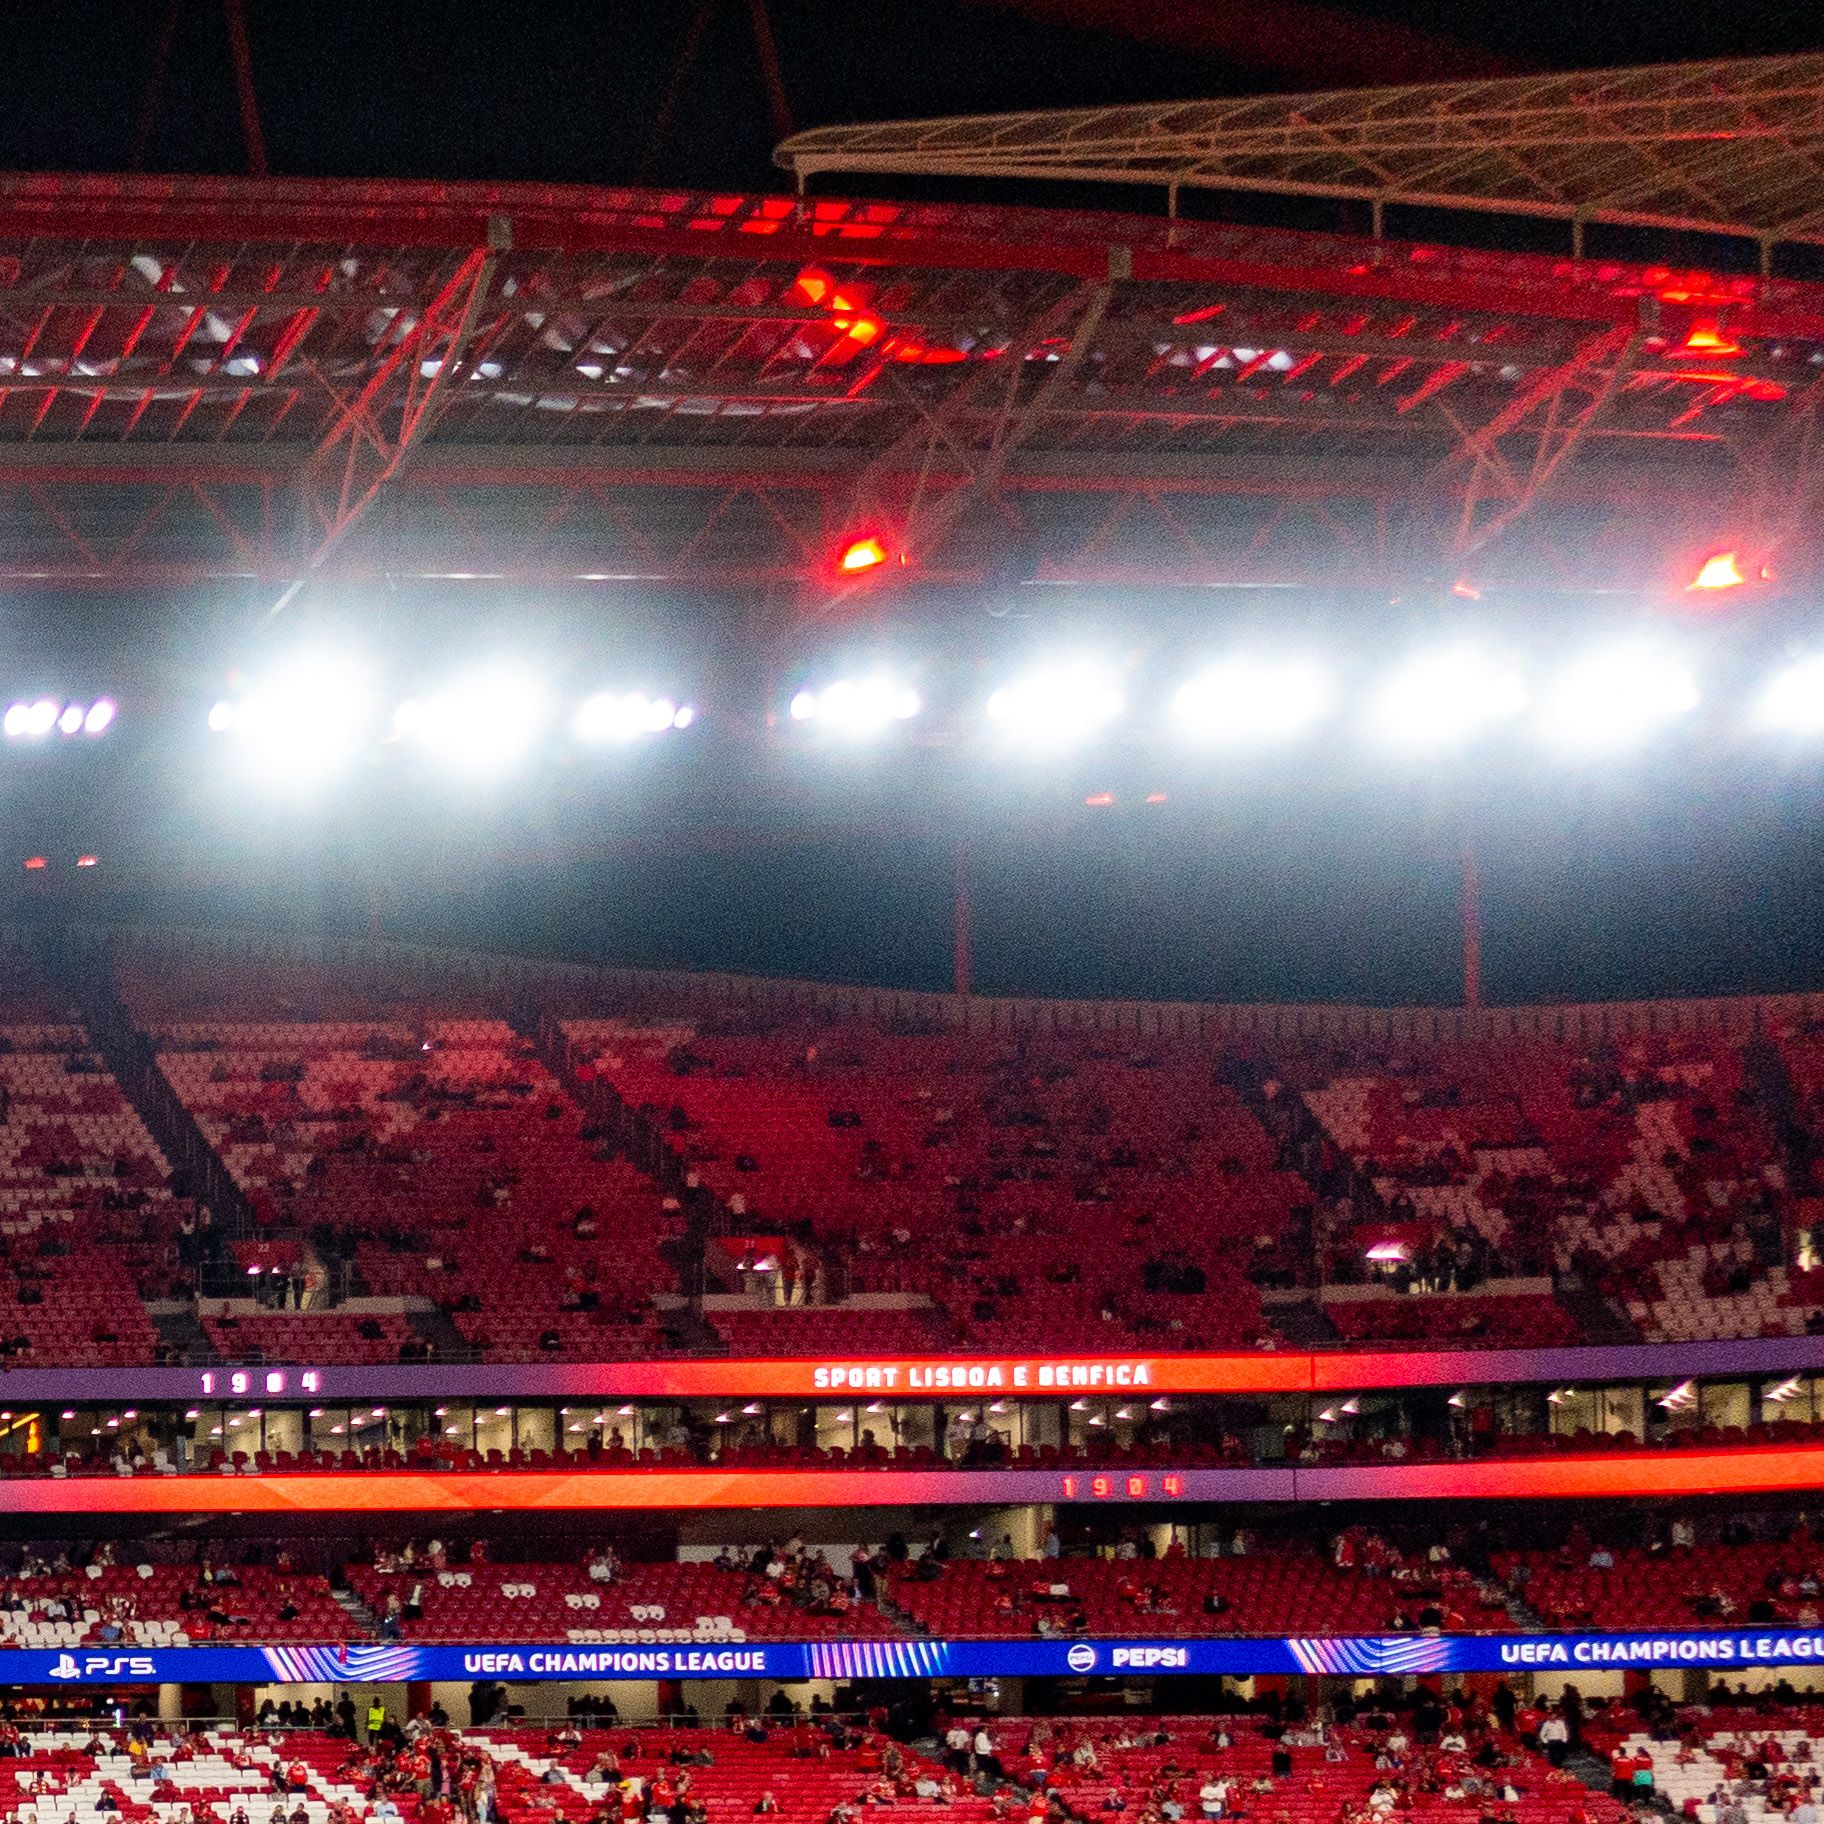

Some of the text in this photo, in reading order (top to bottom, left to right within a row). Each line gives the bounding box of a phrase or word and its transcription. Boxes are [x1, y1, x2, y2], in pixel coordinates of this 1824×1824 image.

[814, 1362, 1150, 1388] SPORT LISBOA E BENFICA
[1112, 1648, 1186, 1667] PEPSI
[1501, 1643, 1569, 1663] UEFA
[1573, 1638, 1735, 1662] CHAMPIONS
[86, 1657, 154, 1675] PS5
[464, 1651, 766, 1673] UEFA CHAMPIONS LEAGUE
